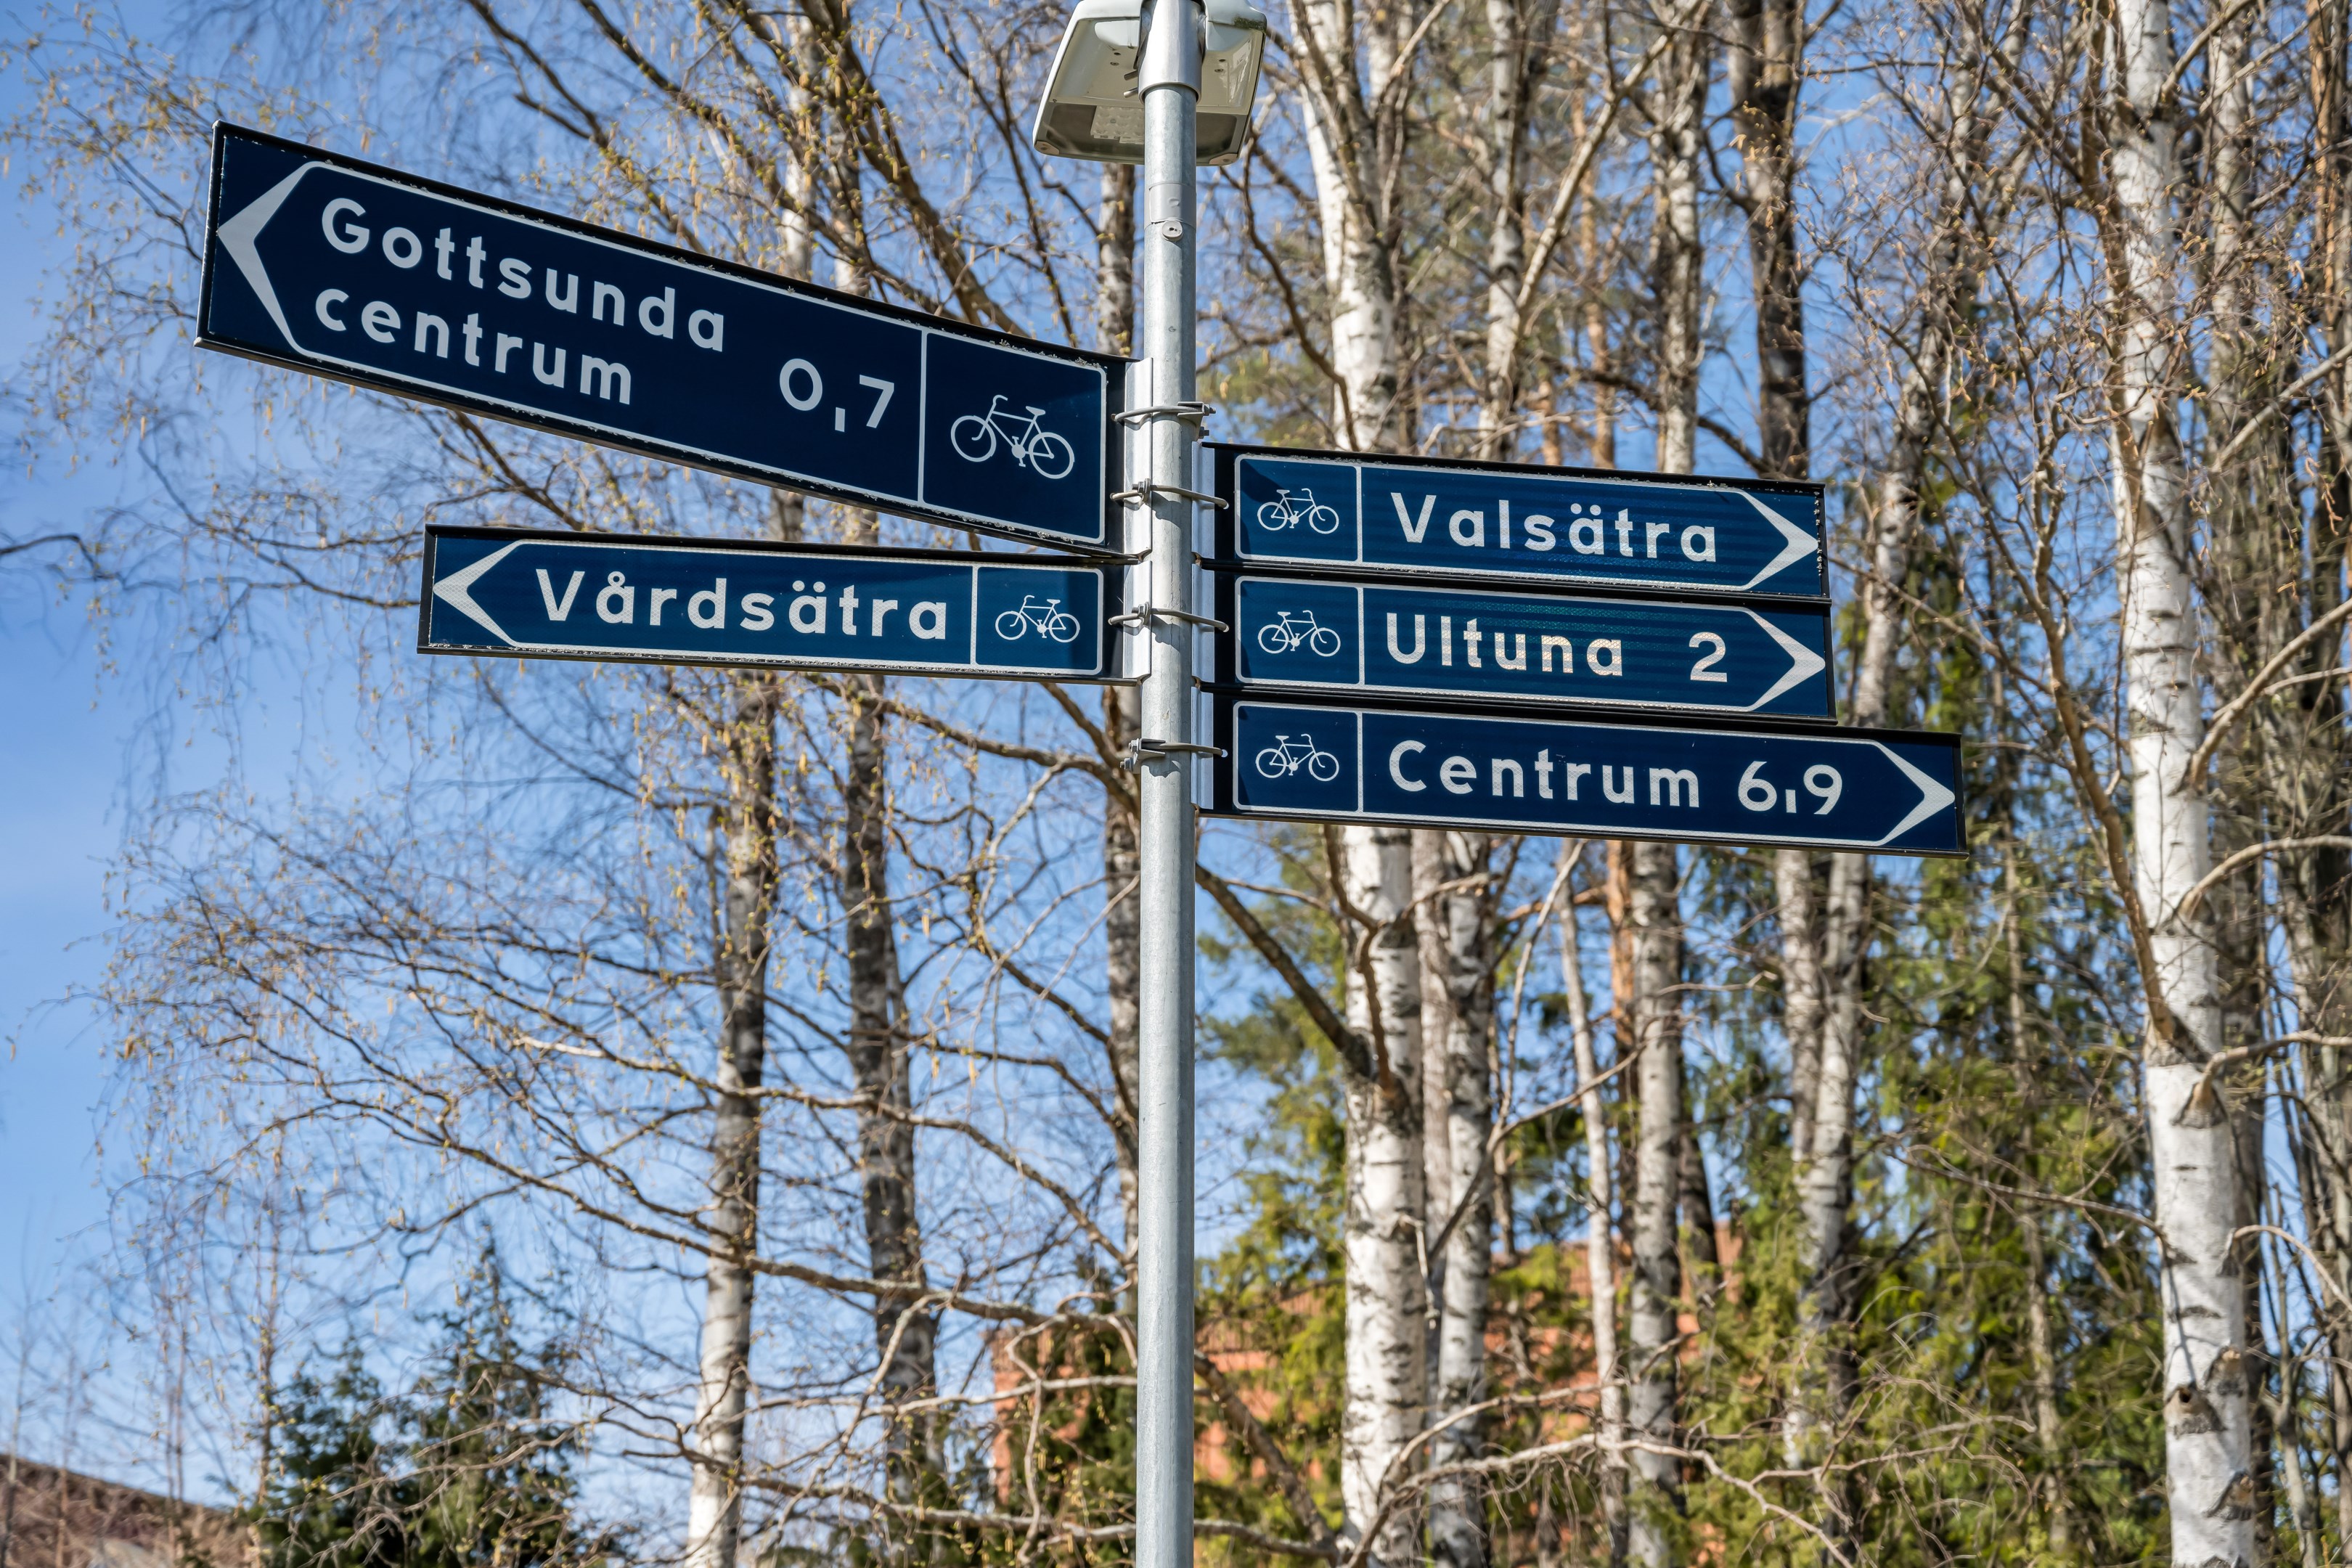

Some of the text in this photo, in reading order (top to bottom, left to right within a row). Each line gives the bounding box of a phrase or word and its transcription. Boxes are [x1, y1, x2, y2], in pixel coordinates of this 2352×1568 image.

[322, 198, 724, 352] Gottsunda
[316, 289, 631, 405] centrum
[780, 359, 894, 432] 0,7
[1390, 492, 1716, 563] Valsätra
[536, 568, 947, 640] Vårdsätra
[1387, 612, 1728, 682] Ultuna 2
[1389, 740, 1842, 815] Centrum 6,9
